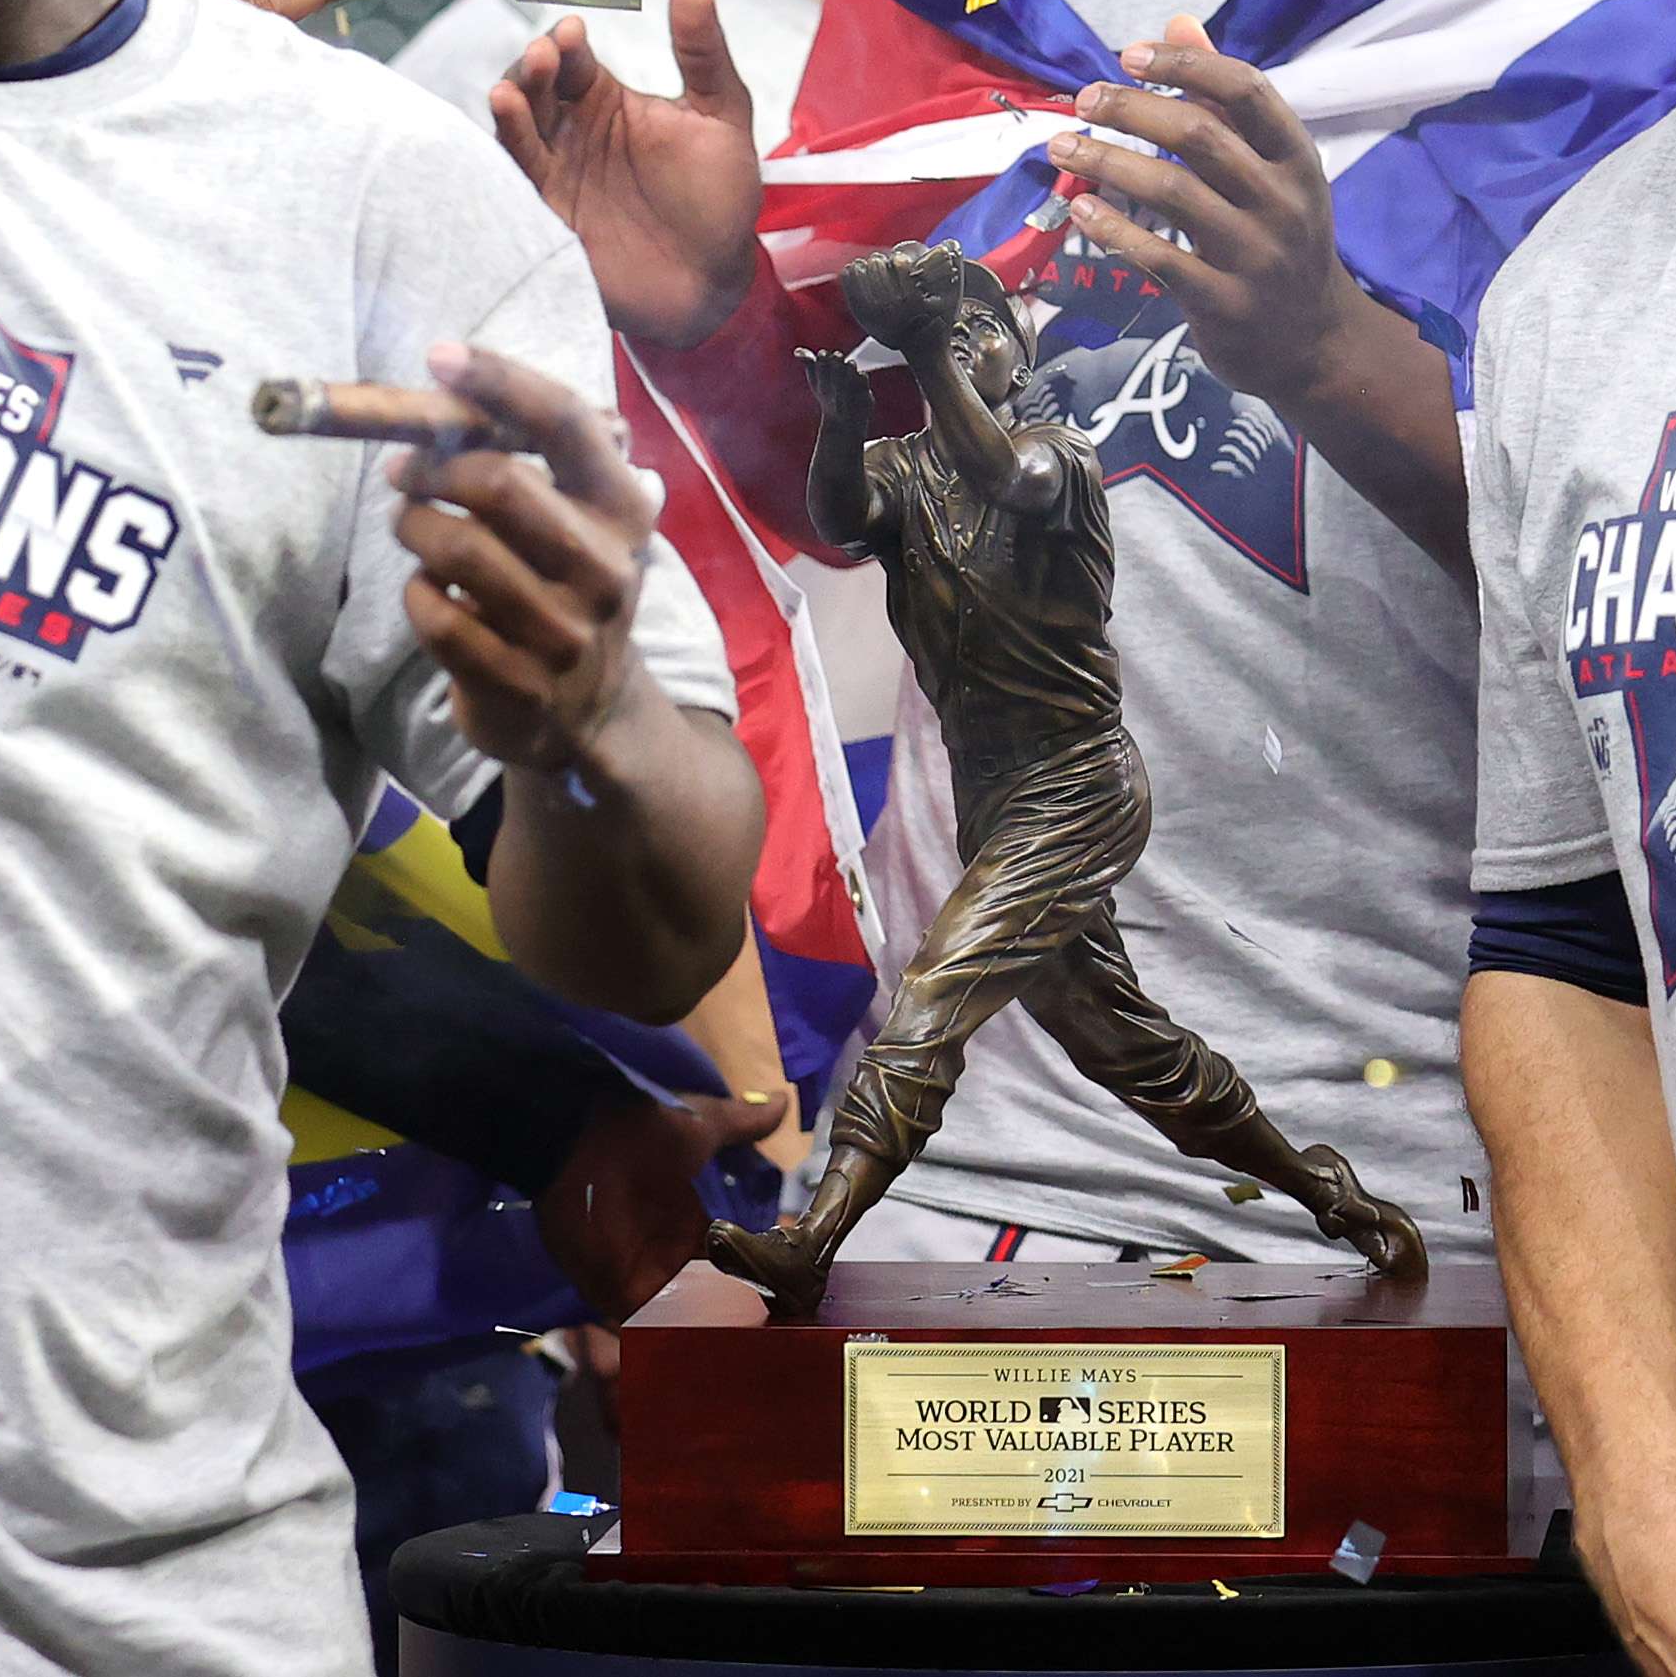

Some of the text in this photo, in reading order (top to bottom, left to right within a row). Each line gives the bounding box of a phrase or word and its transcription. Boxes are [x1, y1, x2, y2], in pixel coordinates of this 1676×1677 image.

[1066, 321, 1198, 461] A
[993, 1368, 1138, 1383] WILLIE MAYS
[915, 1399, 1207, 1425] WORLD SERIES
[1043, 1468, 1087, 1484] 2021
[951, 1496, 1173, 1509] PRESENTED BY CHEVROLET
